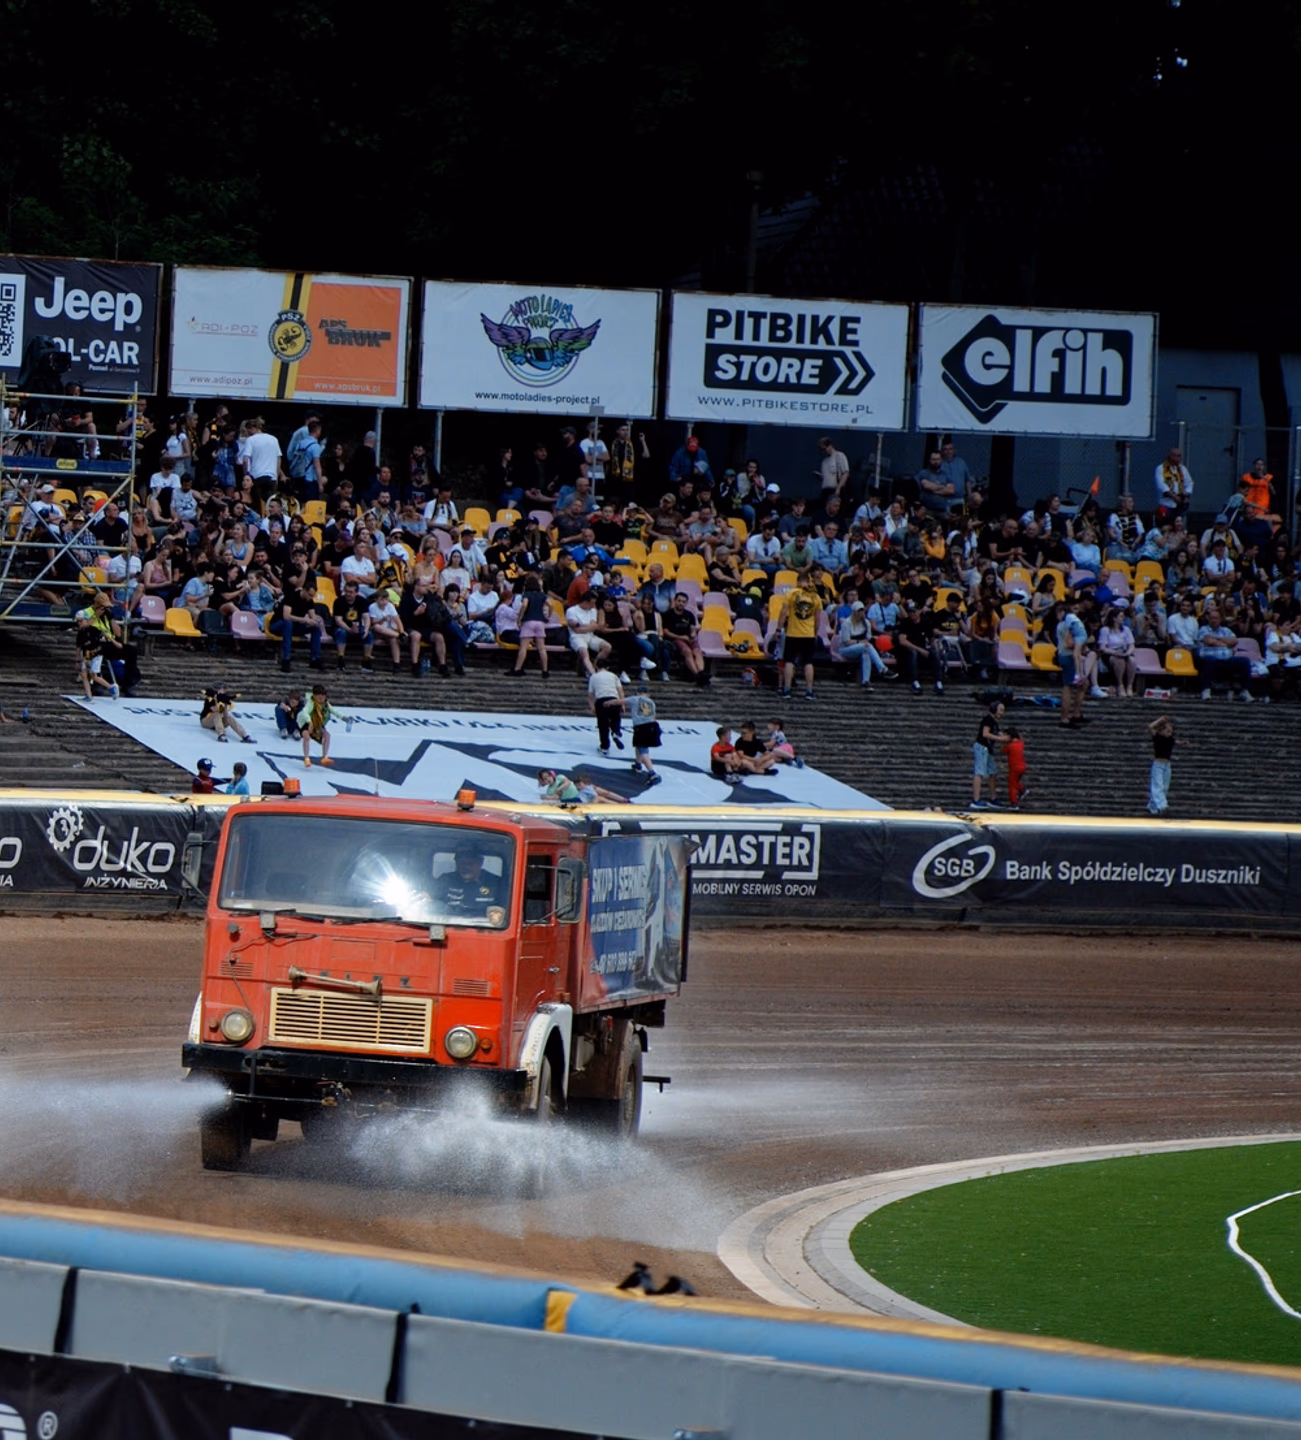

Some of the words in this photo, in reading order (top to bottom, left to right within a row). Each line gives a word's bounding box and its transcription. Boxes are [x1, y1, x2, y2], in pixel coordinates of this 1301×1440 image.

[34, 276, 143, 331] Jeep
[705, 308, 862, 347] PITBIKE
[327, 330, 382, 348] BRUK
[52, 336, 140, 365] OL-CAR
[714, 353, 823, 385] STORE
[964, 326, 1123, 397] elfih
[189, 374, 253, 385] www.adipoz.pl
[314, 381, 381, 393] www.apsbruk.pl
[475, 391, 600, 405] www.motoladies-project.pl
[697, 396, 874, 415] WWW.PITBIKESTORE.PL
[73, 825, 175, 875] duko
[933, 857, 976, 877] SGB
[1005, 859, 1053, 880] Bank
[1056, 859, 1177, 887] Spółdzielczy
[1180, 863, 1260, 885] Duszniki
[83, 874, 169, 891] INŻYNIERIA
[692, 881, 740, 895] MOBILNY
[741, 883, 781, 897] SERWIS
[784, 884, 817, 897] OPON
